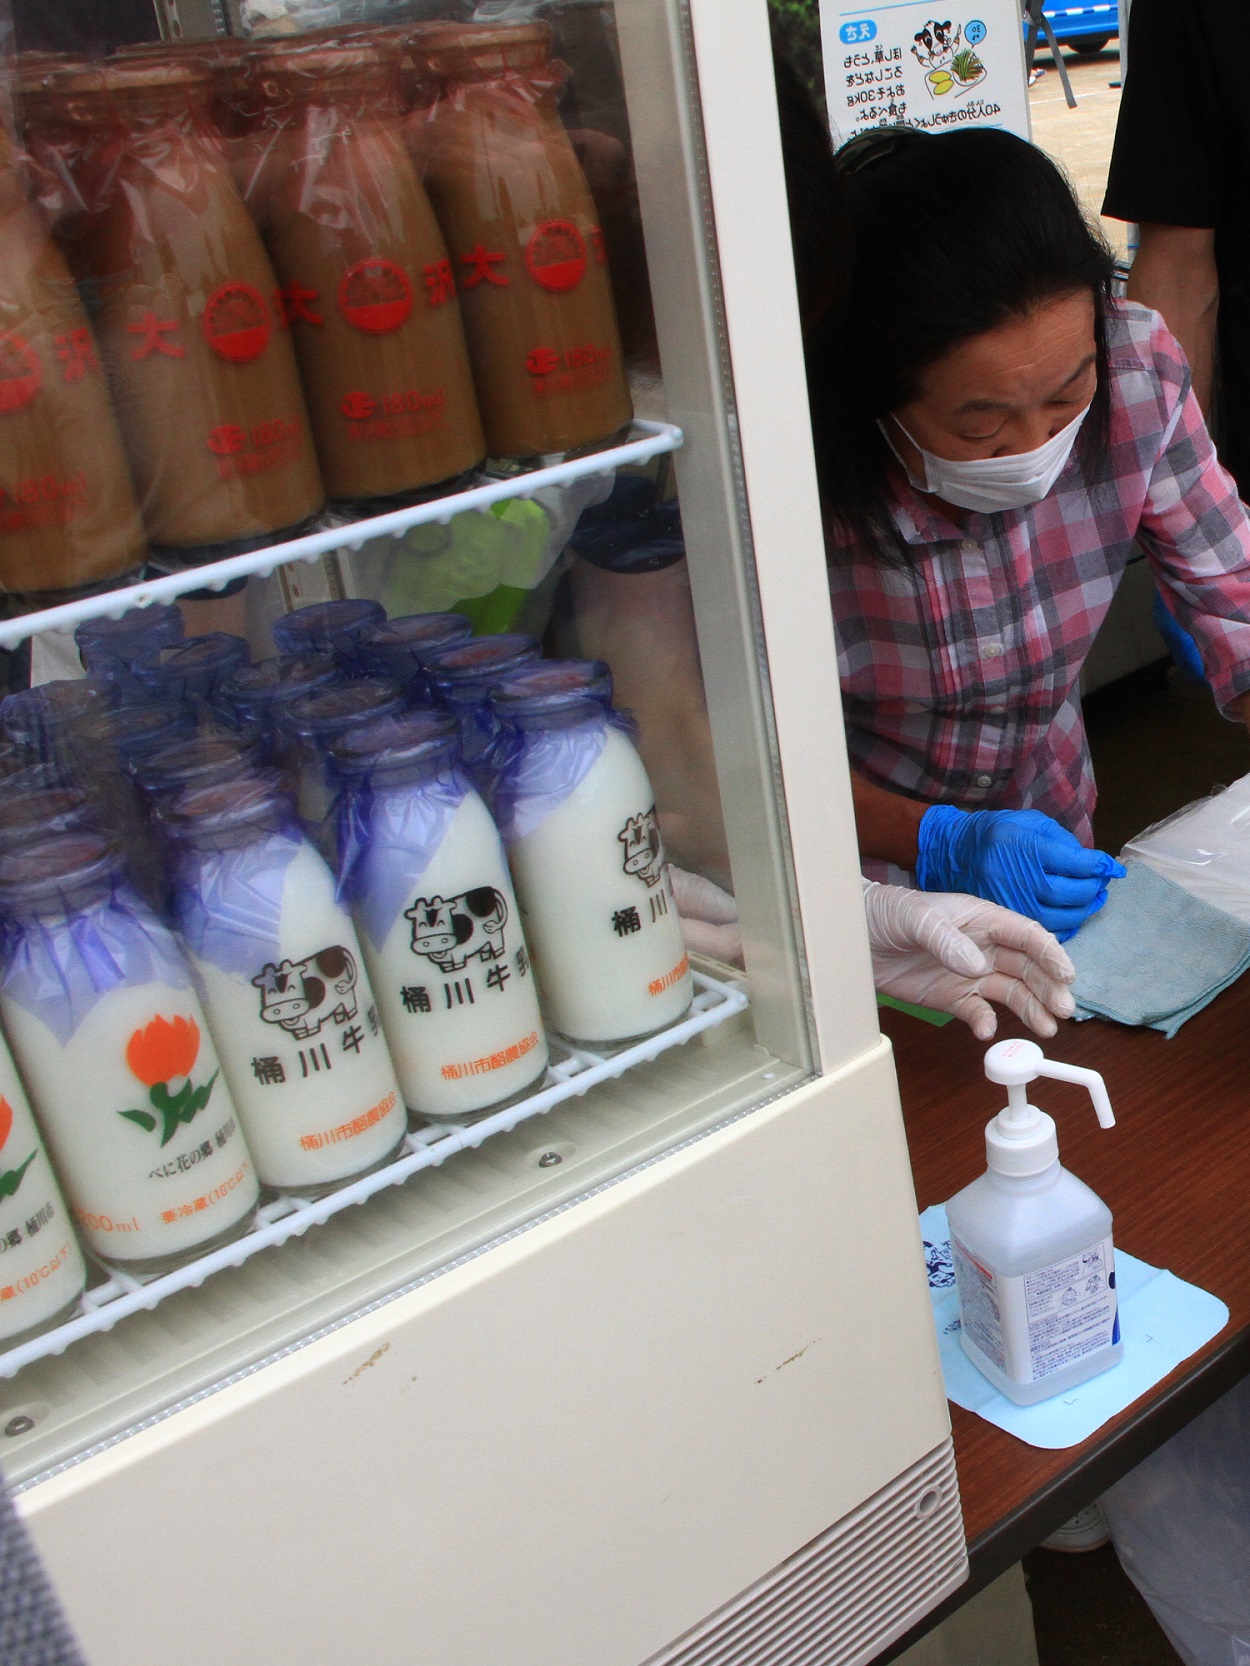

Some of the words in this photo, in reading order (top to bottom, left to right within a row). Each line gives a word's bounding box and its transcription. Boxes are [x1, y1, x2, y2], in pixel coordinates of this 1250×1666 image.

[125, 312, 186, 361] 大
[441, 1031, 539, 1080] 桶川市酪農協会
